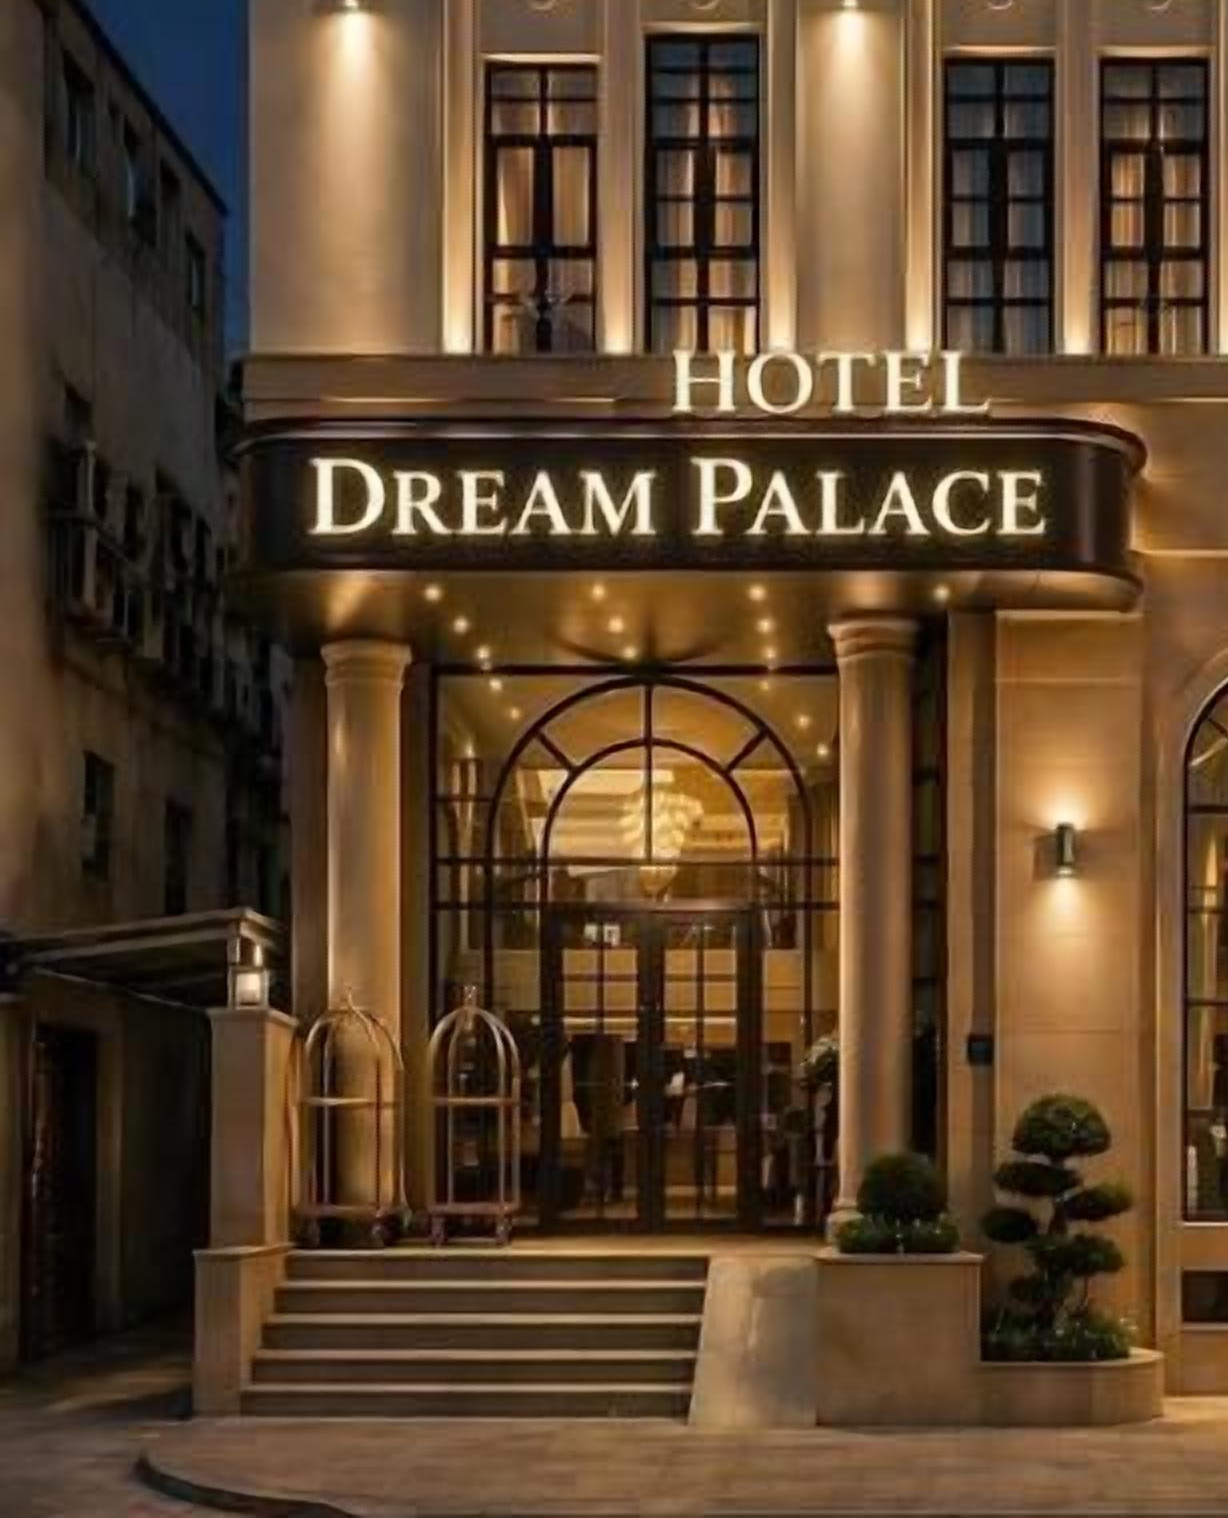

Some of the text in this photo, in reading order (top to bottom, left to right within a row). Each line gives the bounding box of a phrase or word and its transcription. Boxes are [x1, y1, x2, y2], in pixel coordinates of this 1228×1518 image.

[673, 350, 992, 414] HOTEL
[311, 458, 1047, 535] DREAM PALACE
